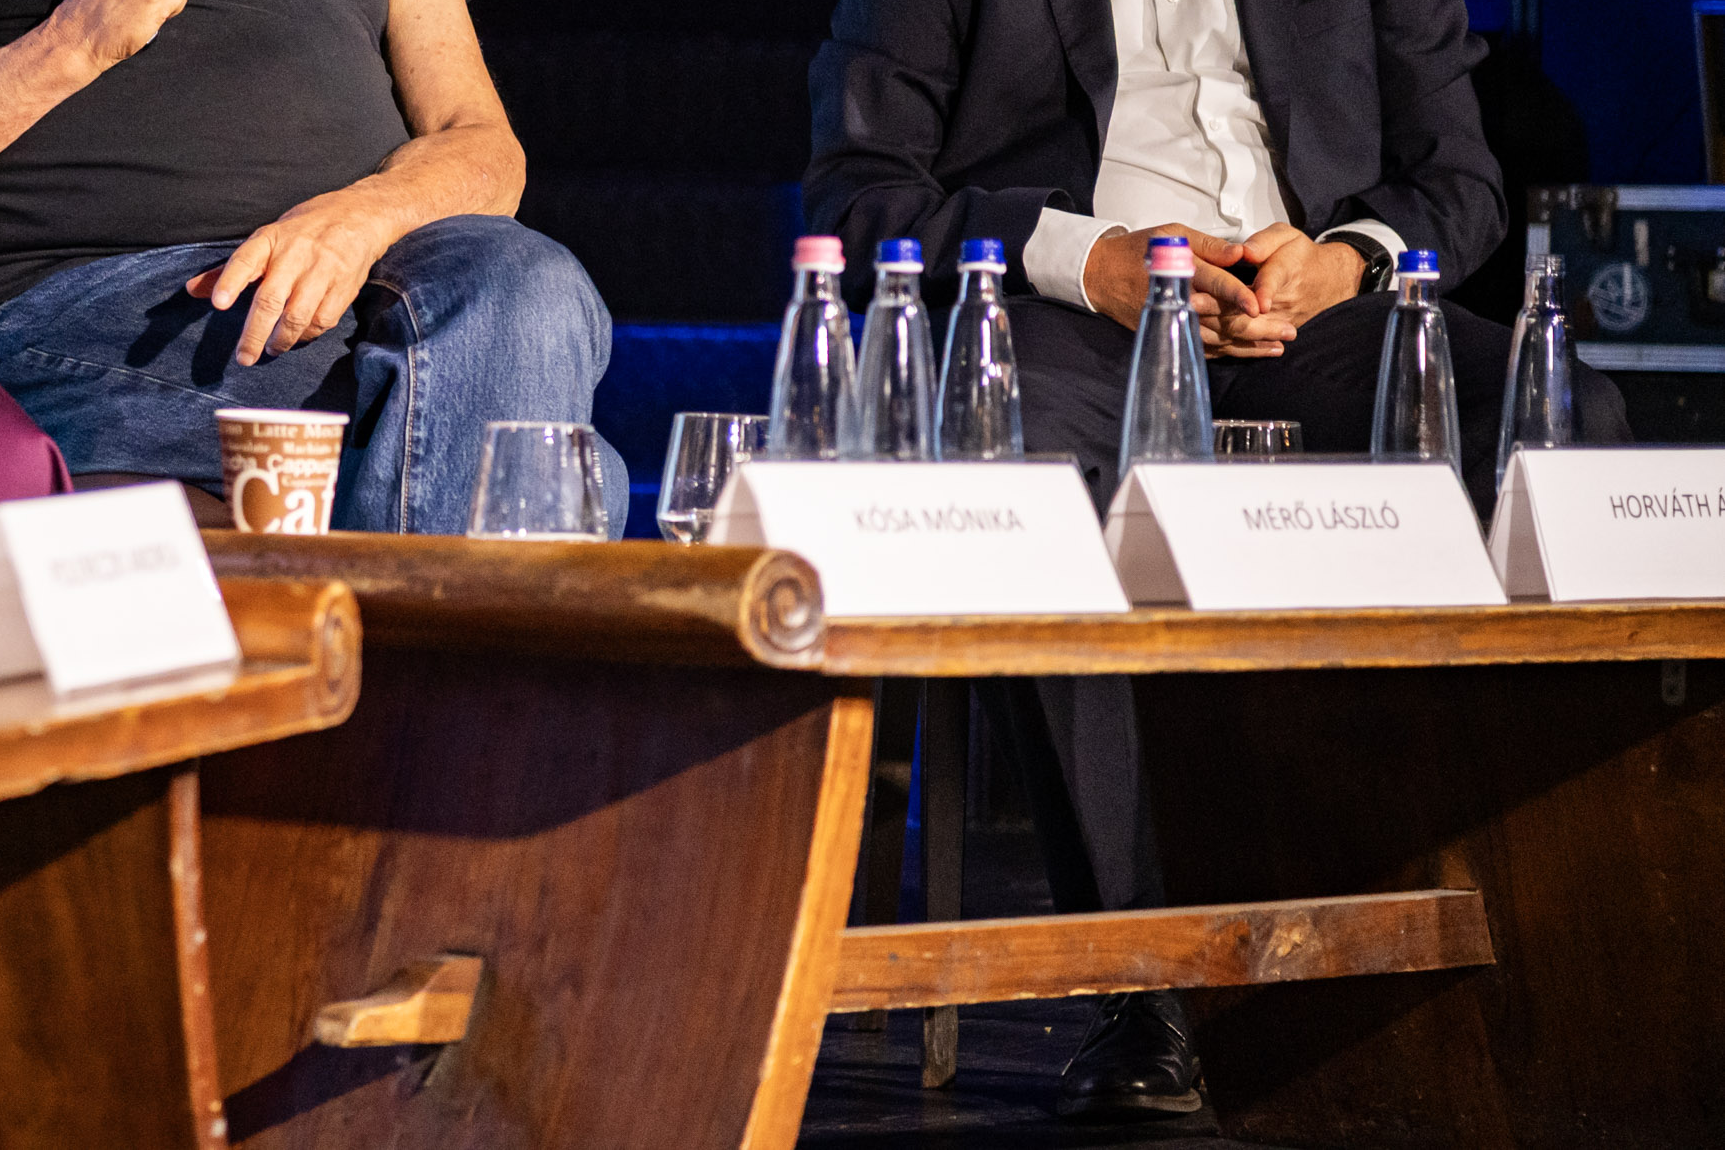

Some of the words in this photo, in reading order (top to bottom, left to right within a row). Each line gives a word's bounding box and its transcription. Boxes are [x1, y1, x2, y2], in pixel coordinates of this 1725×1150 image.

[853, 501, 920, 532] KÓSA
[921, 501, 1026, 532] MÓNIKA
[1242, 500, 1314, 531] MÉRŐ
[1316, 500, 1401, 530] LÁSZLÓ
[1609, 487, 1712, 519] HORVÁTH
